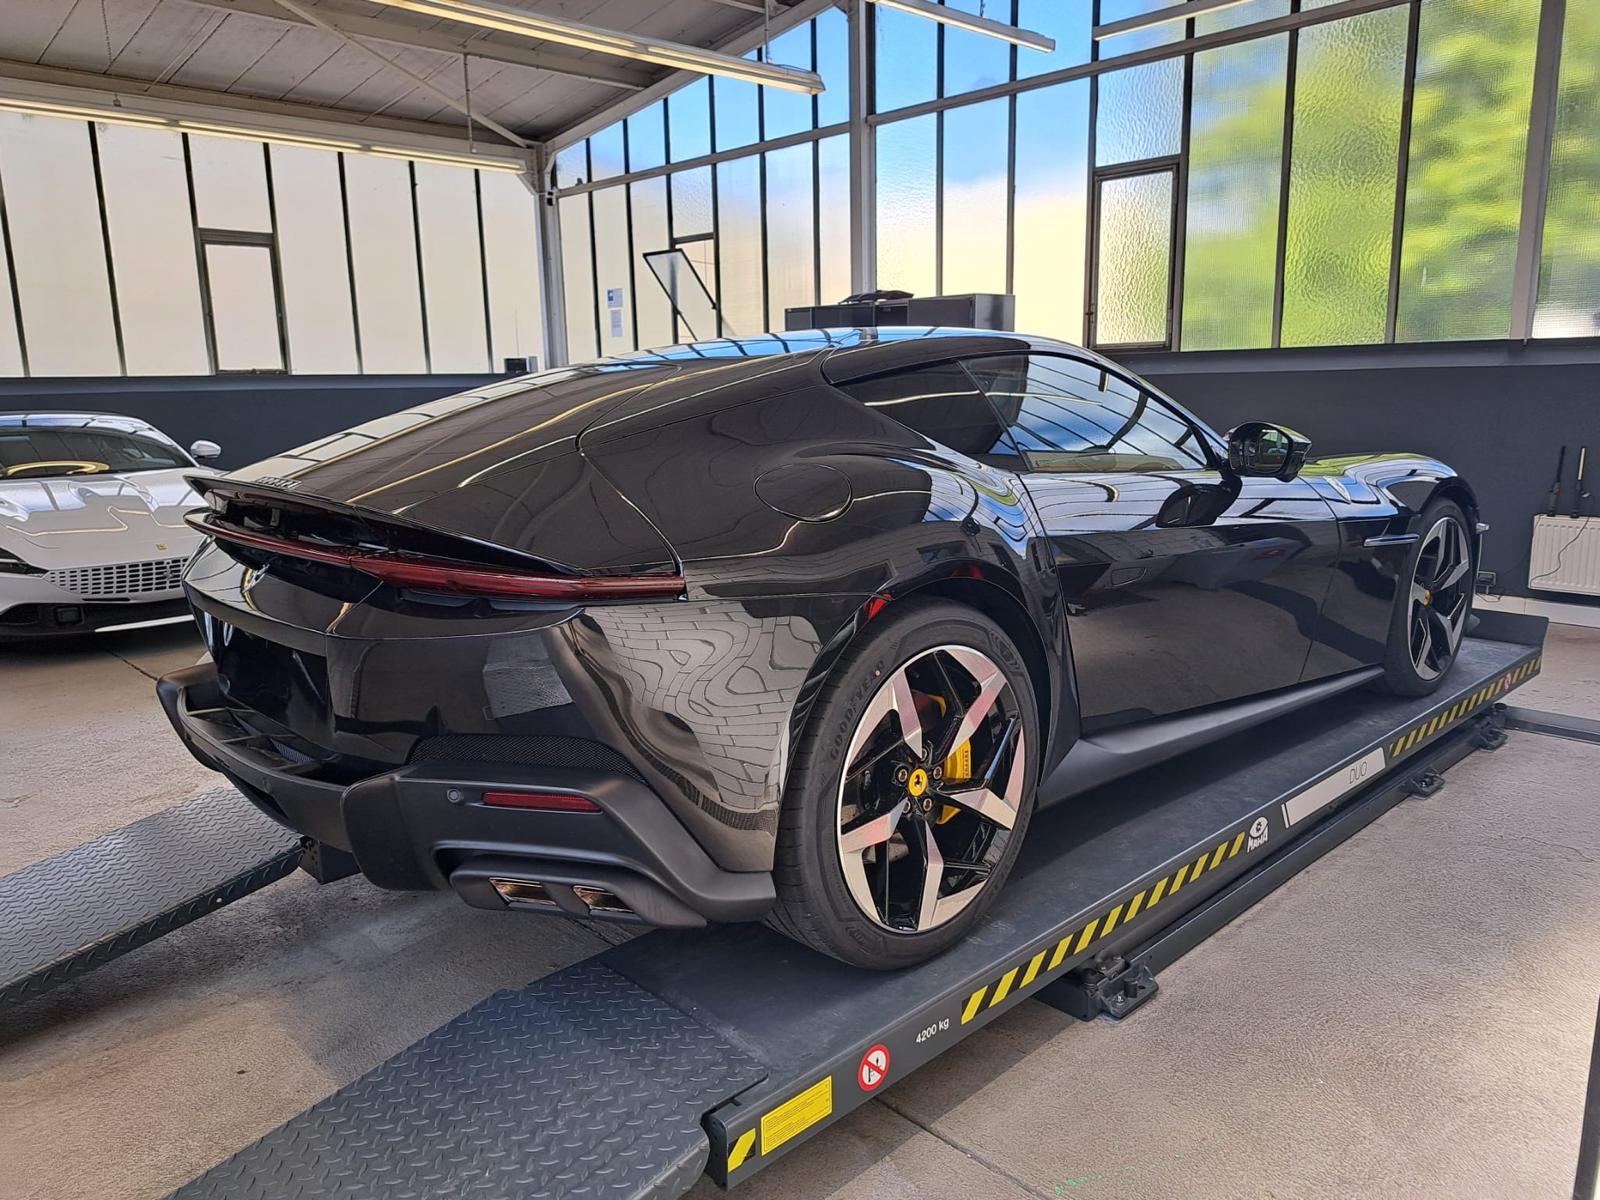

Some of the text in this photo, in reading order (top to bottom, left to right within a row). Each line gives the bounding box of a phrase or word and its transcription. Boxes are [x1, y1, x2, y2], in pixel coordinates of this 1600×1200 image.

[1349, 761, 1368, 784] DUO
[916, 1018, 950, 1043] 4200 kg
